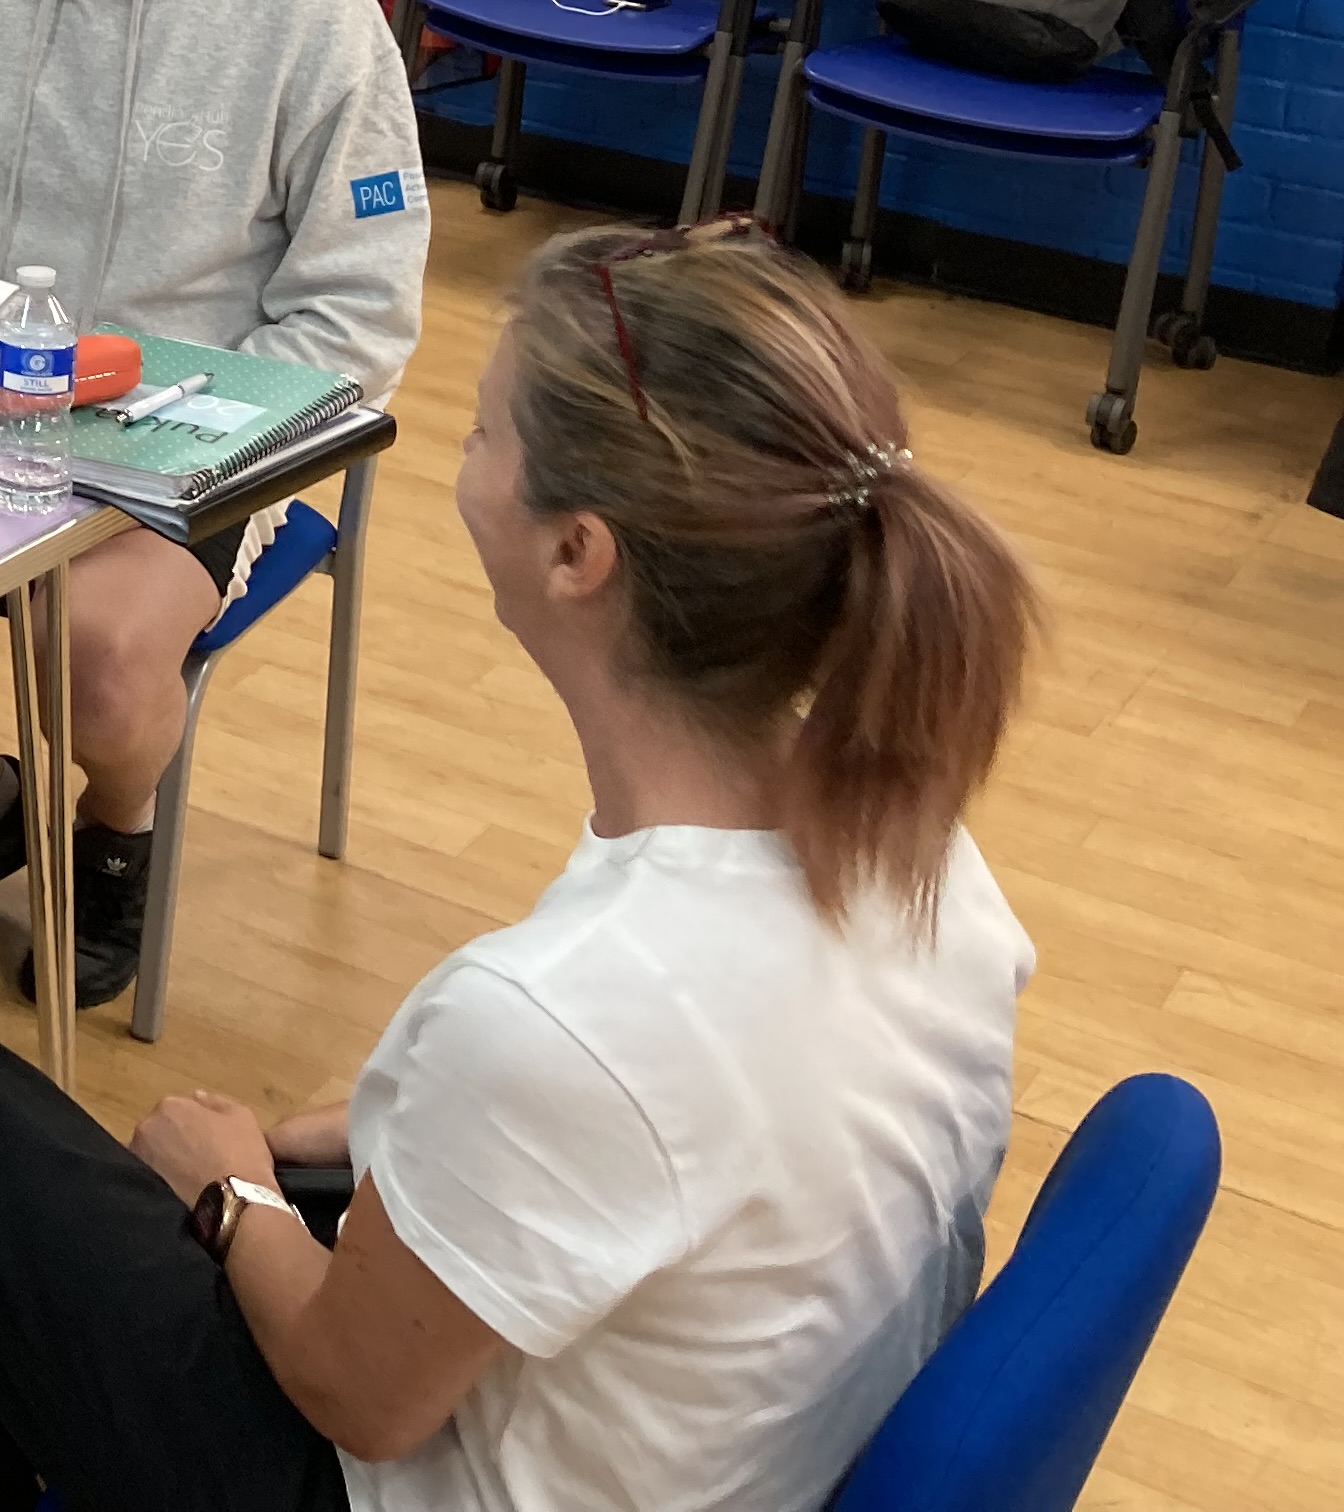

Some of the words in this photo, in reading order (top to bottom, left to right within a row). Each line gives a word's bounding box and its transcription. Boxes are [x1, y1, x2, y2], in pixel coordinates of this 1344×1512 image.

[134, 118, 227, 172] YES
[359, 181, 397, 211] PAC
[24, 378, 50, 388] STILL
